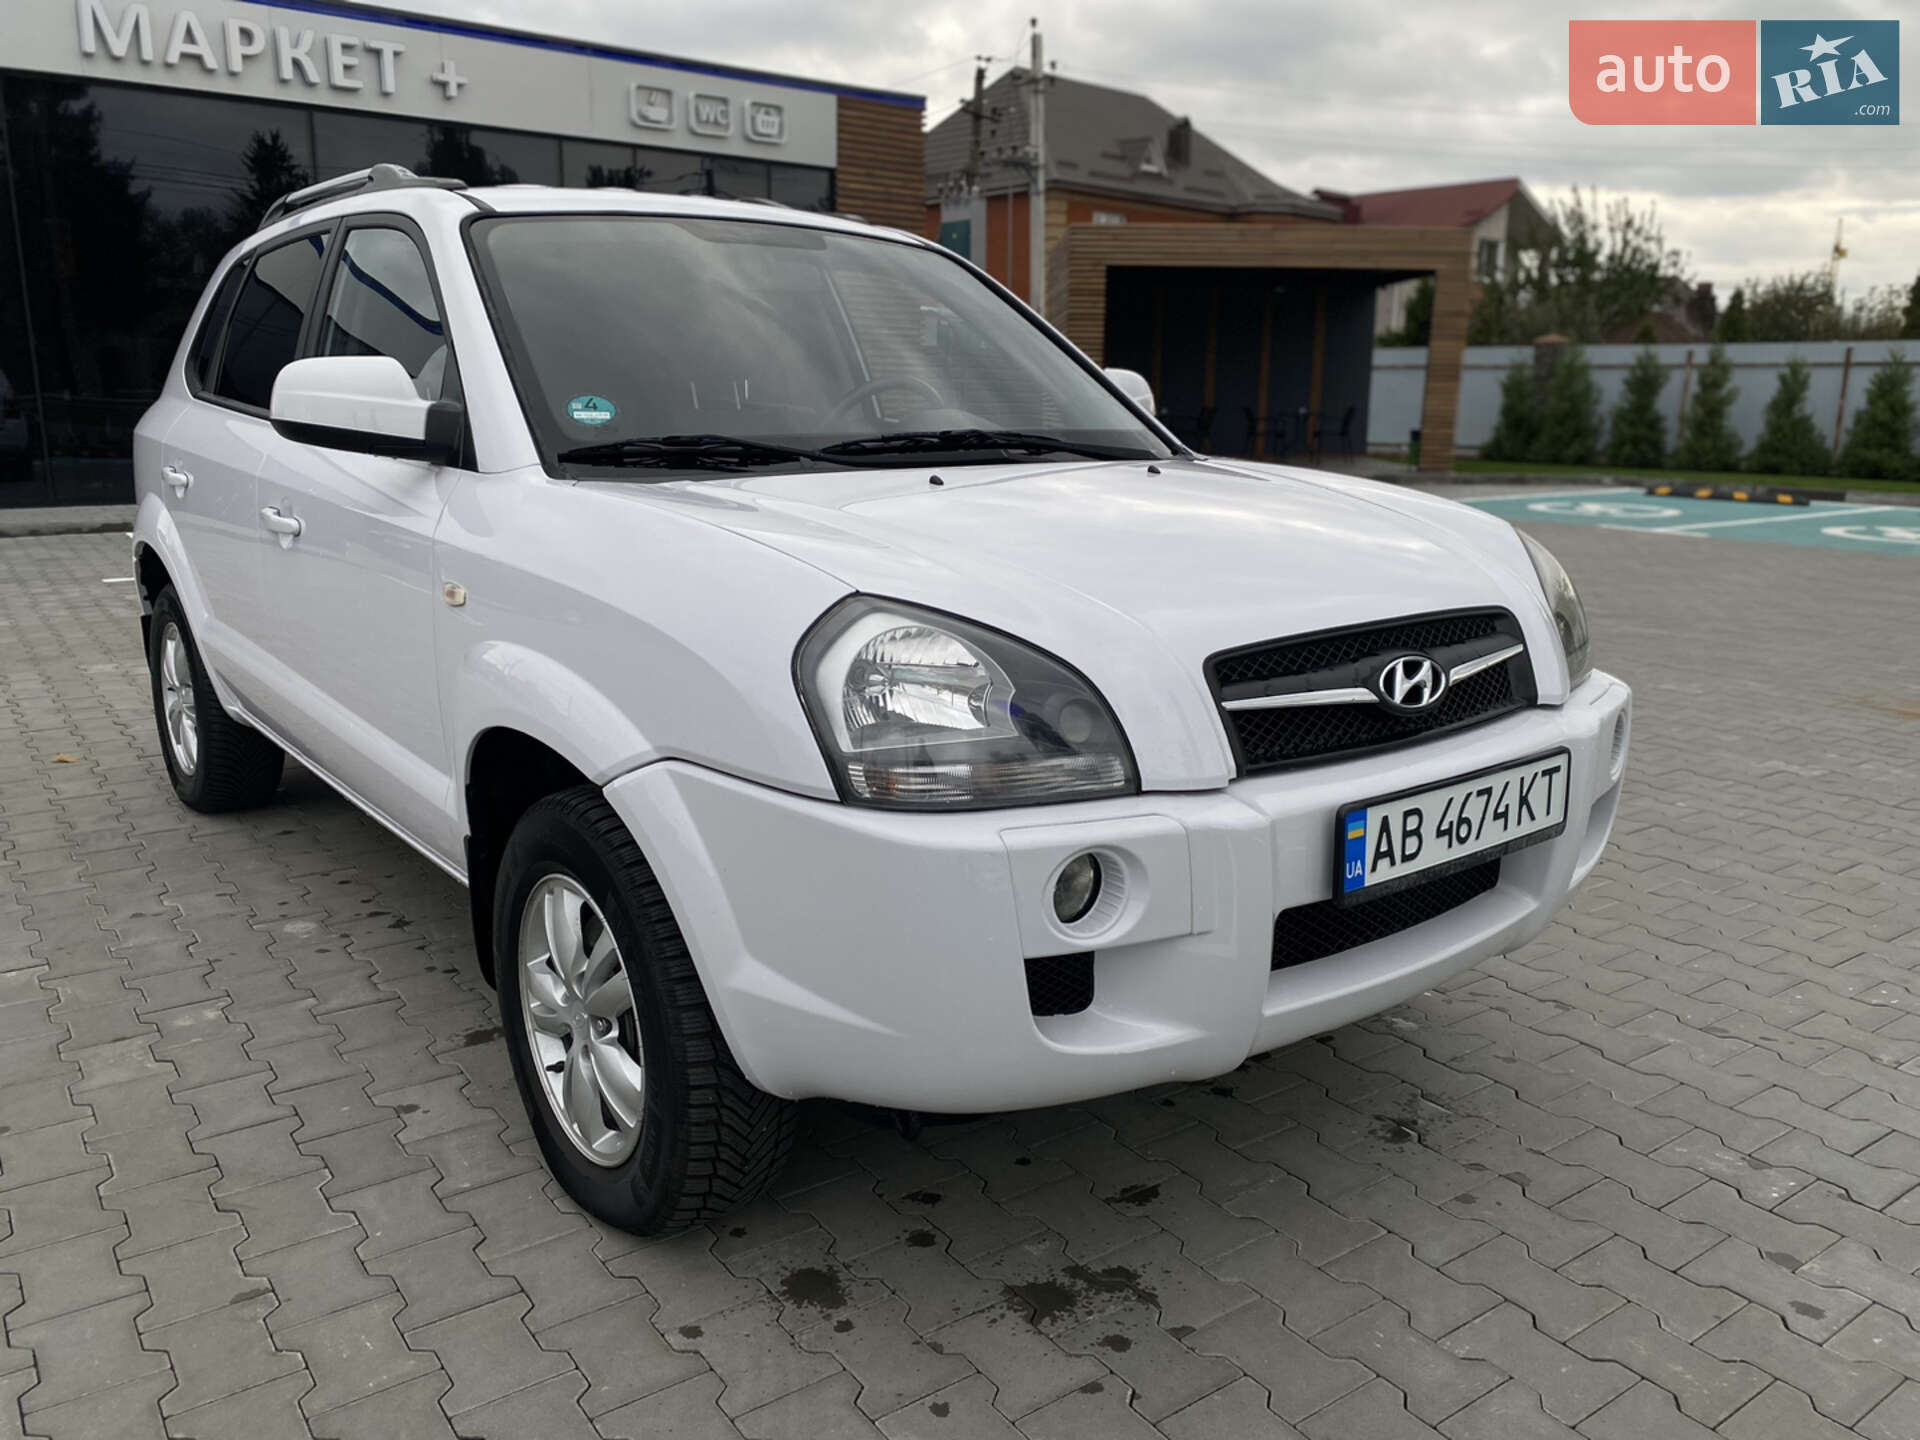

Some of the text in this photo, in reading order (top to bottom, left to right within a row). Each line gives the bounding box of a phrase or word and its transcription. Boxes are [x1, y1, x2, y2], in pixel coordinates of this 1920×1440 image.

[76, 0, 406, 95] МАРКЕТ
[700, 103, 729, 125] WC
[584, 397, 598, 411] 4
[1370, 807, 1424, 873] AB
[1346, 859, 1363, 879] UA
